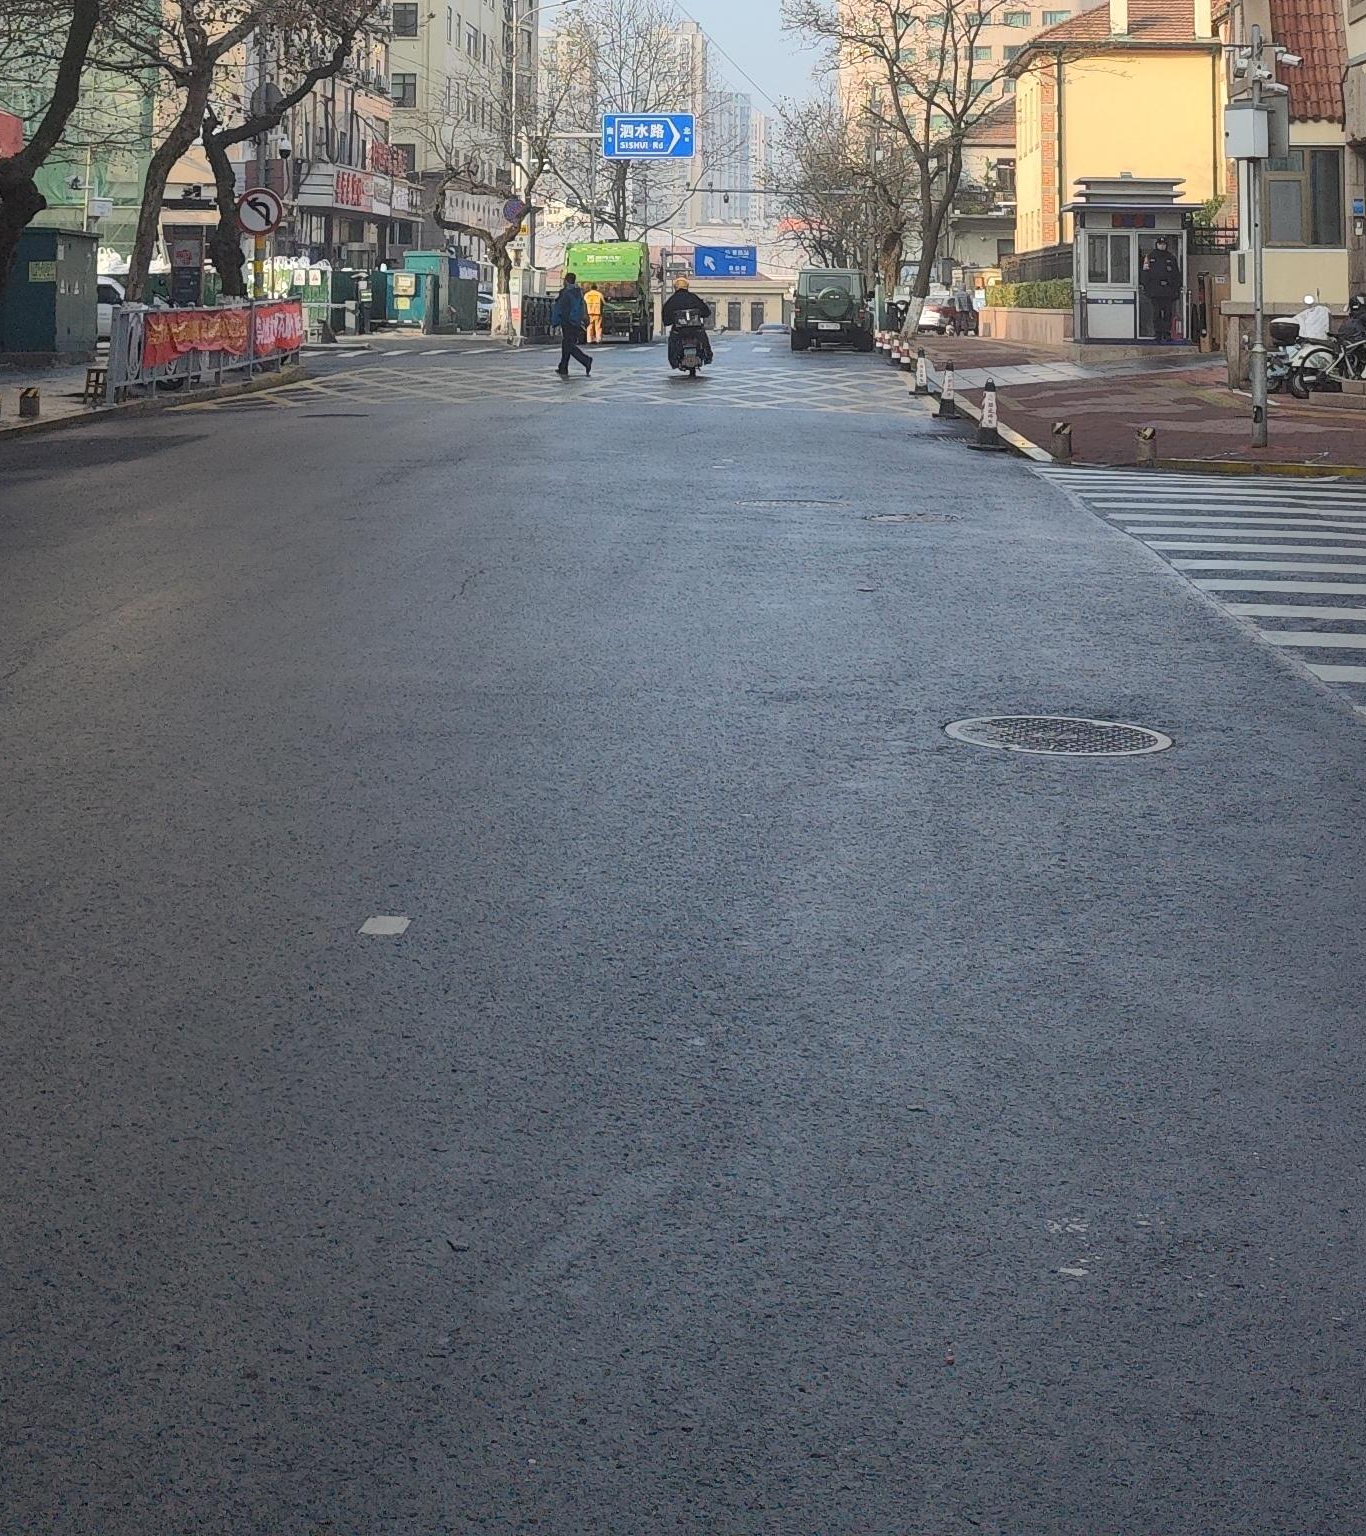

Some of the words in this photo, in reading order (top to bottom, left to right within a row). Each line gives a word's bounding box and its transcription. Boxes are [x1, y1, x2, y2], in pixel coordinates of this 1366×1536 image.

[619, 123, 665, 139] 泗水路
[619, 141, 648, 149] SISHUI
[652, 141, 664, 149] Rd
